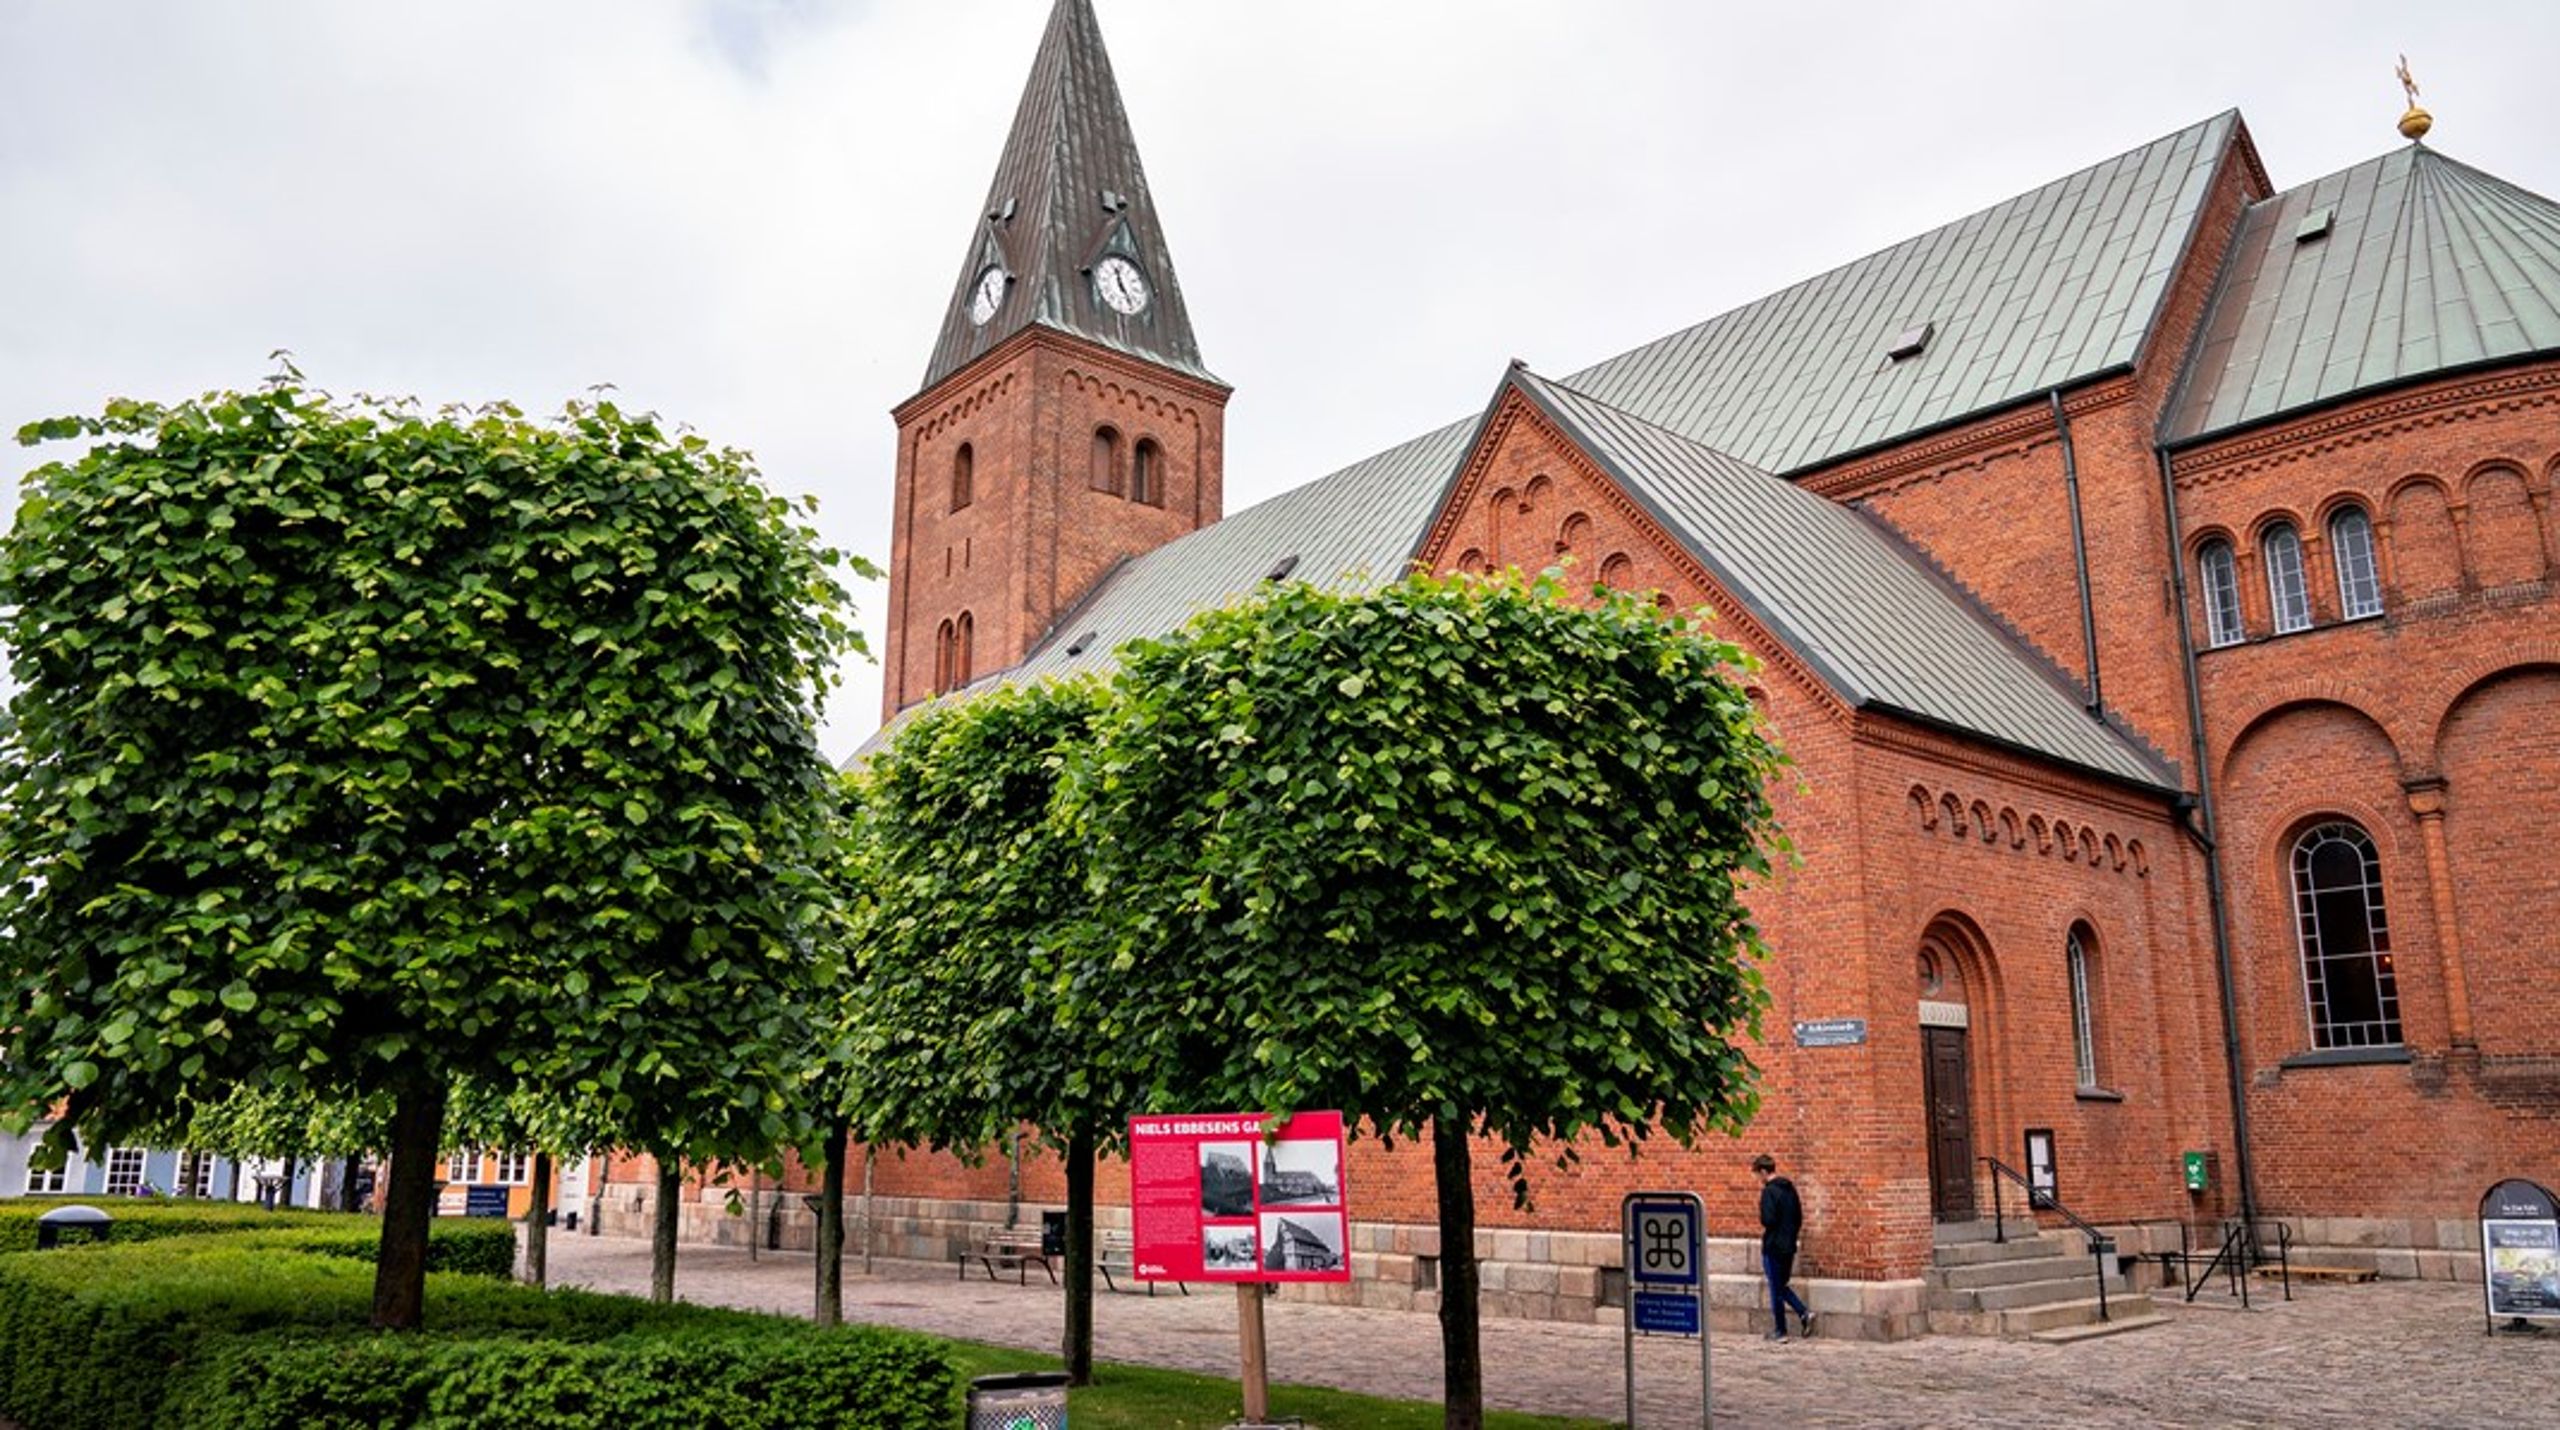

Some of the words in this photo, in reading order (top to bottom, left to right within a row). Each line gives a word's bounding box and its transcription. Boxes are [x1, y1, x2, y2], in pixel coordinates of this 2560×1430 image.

[1135, 1122, 1171, 1135] NIELS
[1173, 1121, 1240, 1135] EBBESENS
[1241, 1120, 1279, 1134] GA
